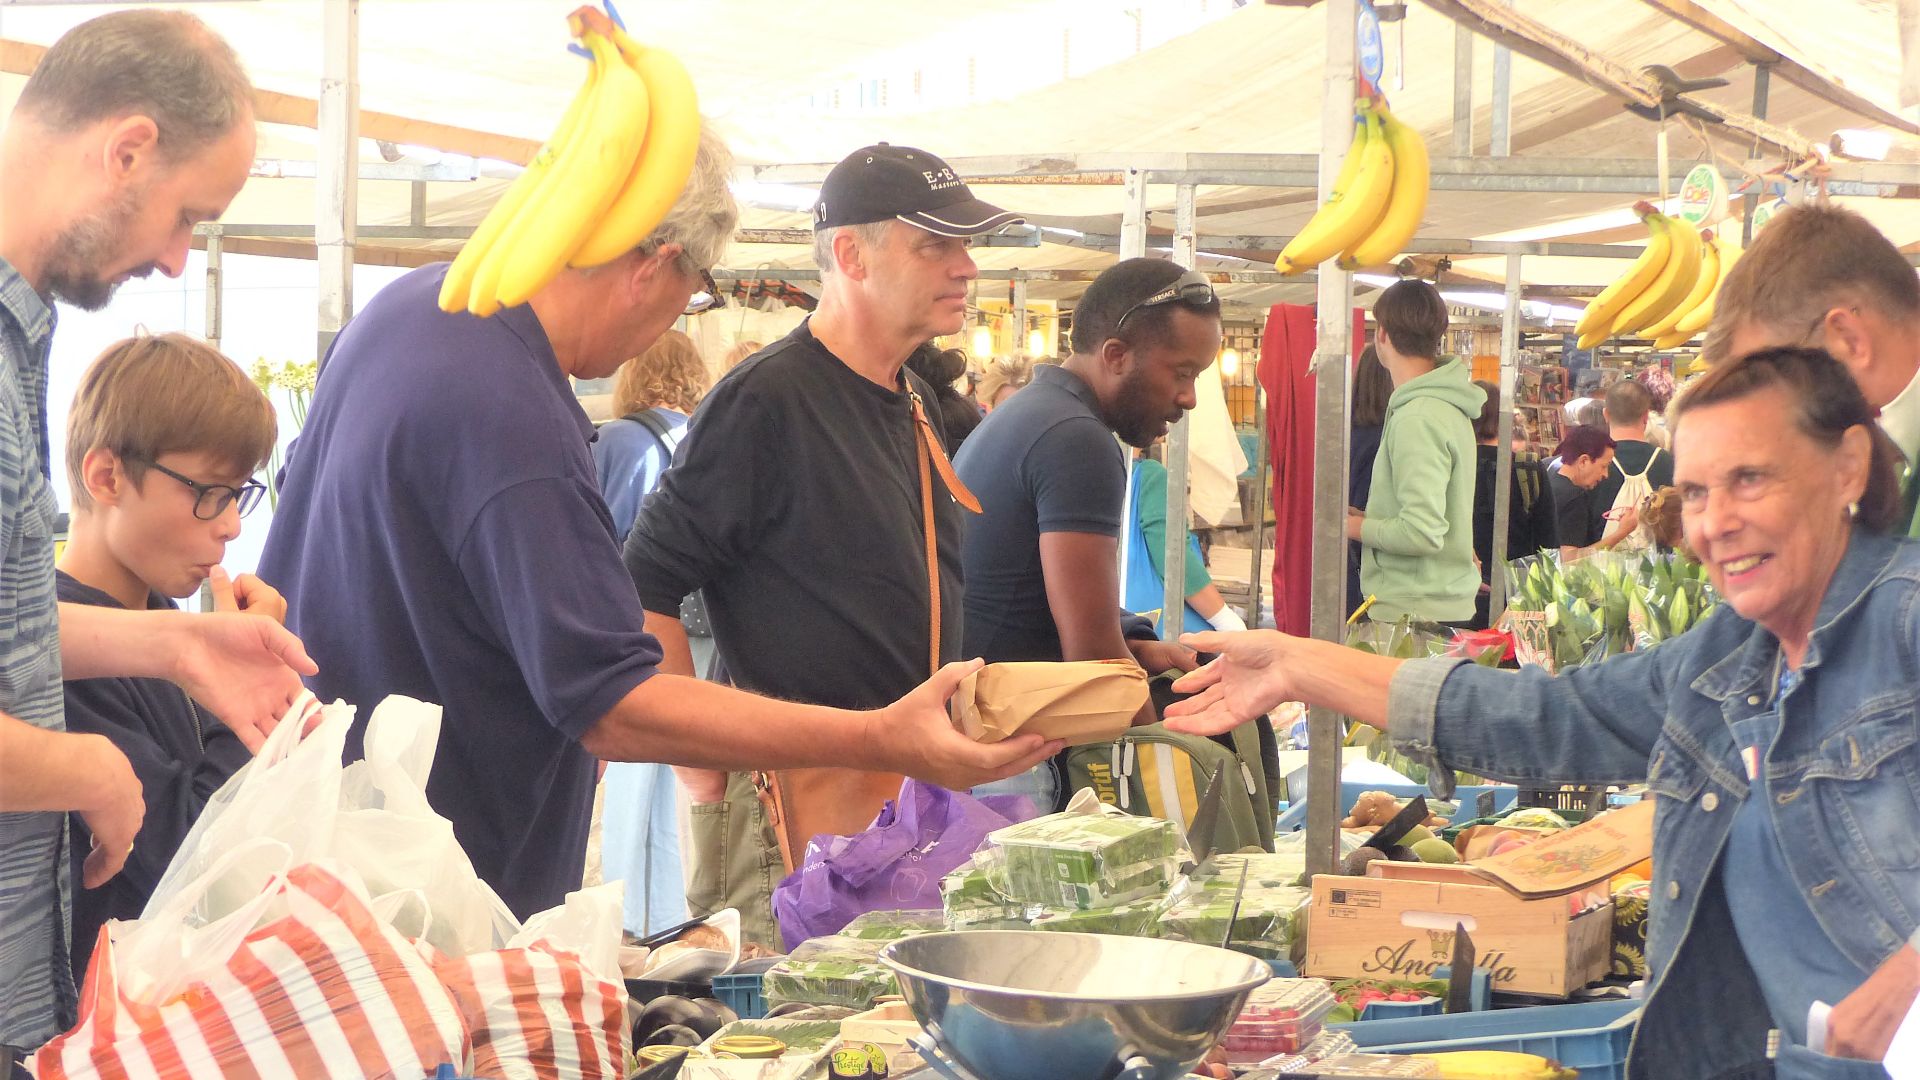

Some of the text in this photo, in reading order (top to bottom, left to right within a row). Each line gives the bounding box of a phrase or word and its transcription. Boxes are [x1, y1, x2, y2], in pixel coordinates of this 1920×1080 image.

[1684, 186, 1709, 201] Dole
[1151, 289, 1175, 302] VERSACE
[834, 1052, 868, 1074] Prestige
